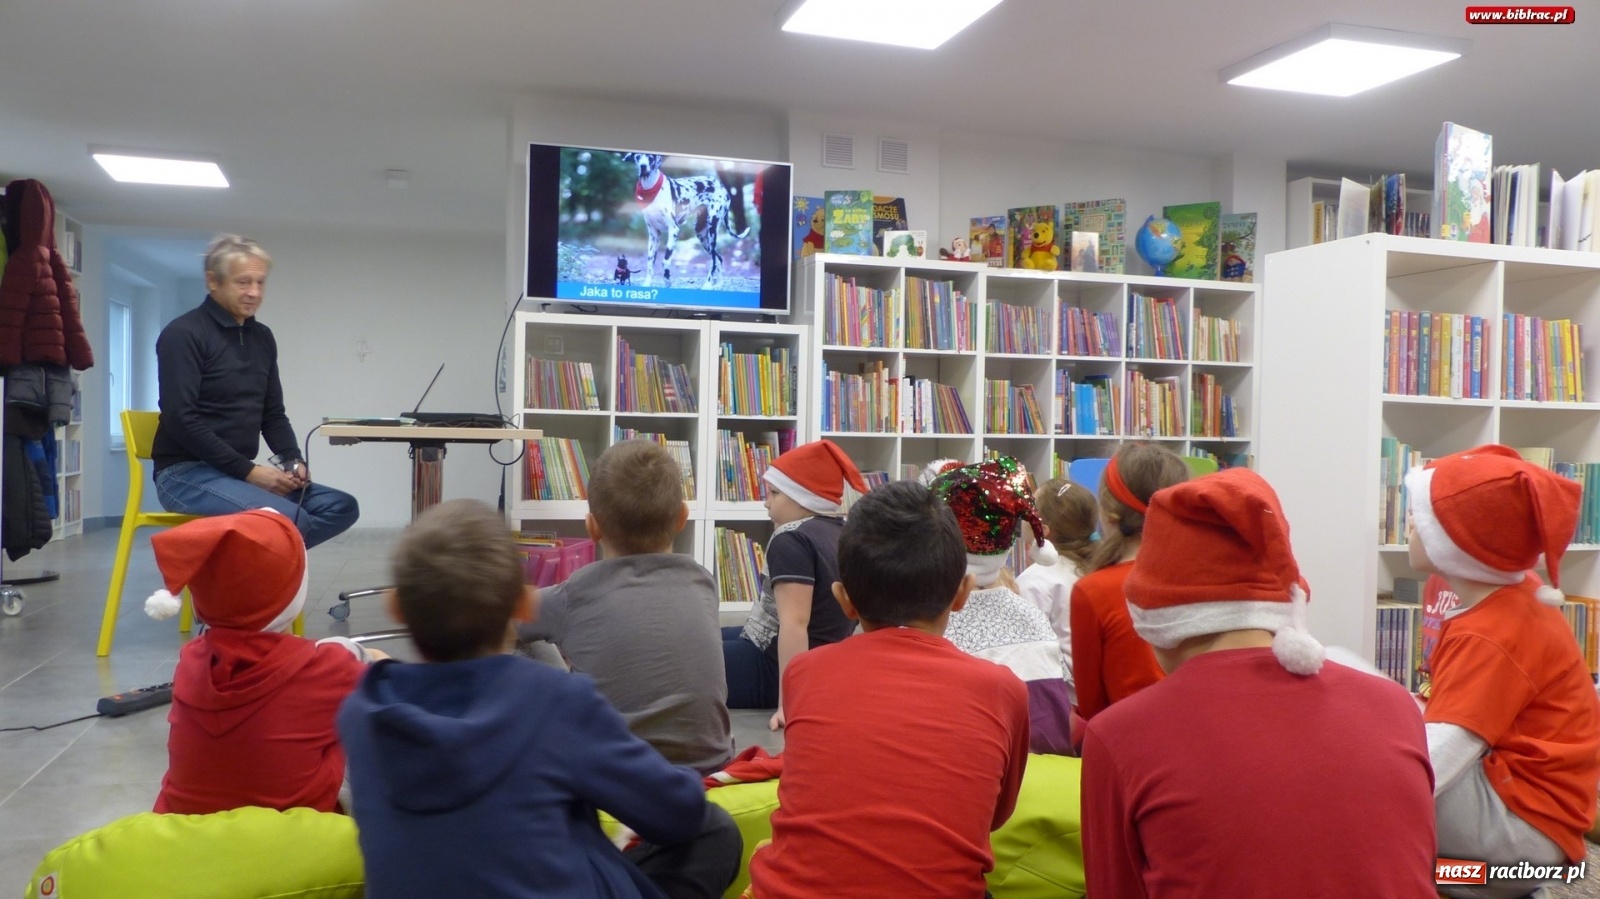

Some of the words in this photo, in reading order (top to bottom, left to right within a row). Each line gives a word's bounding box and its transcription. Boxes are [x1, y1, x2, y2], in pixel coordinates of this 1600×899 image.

[580, 286, 608, 298] Jaka
[611, 287, 623, 299] to
[626, 289, 659, 300] rasa?
